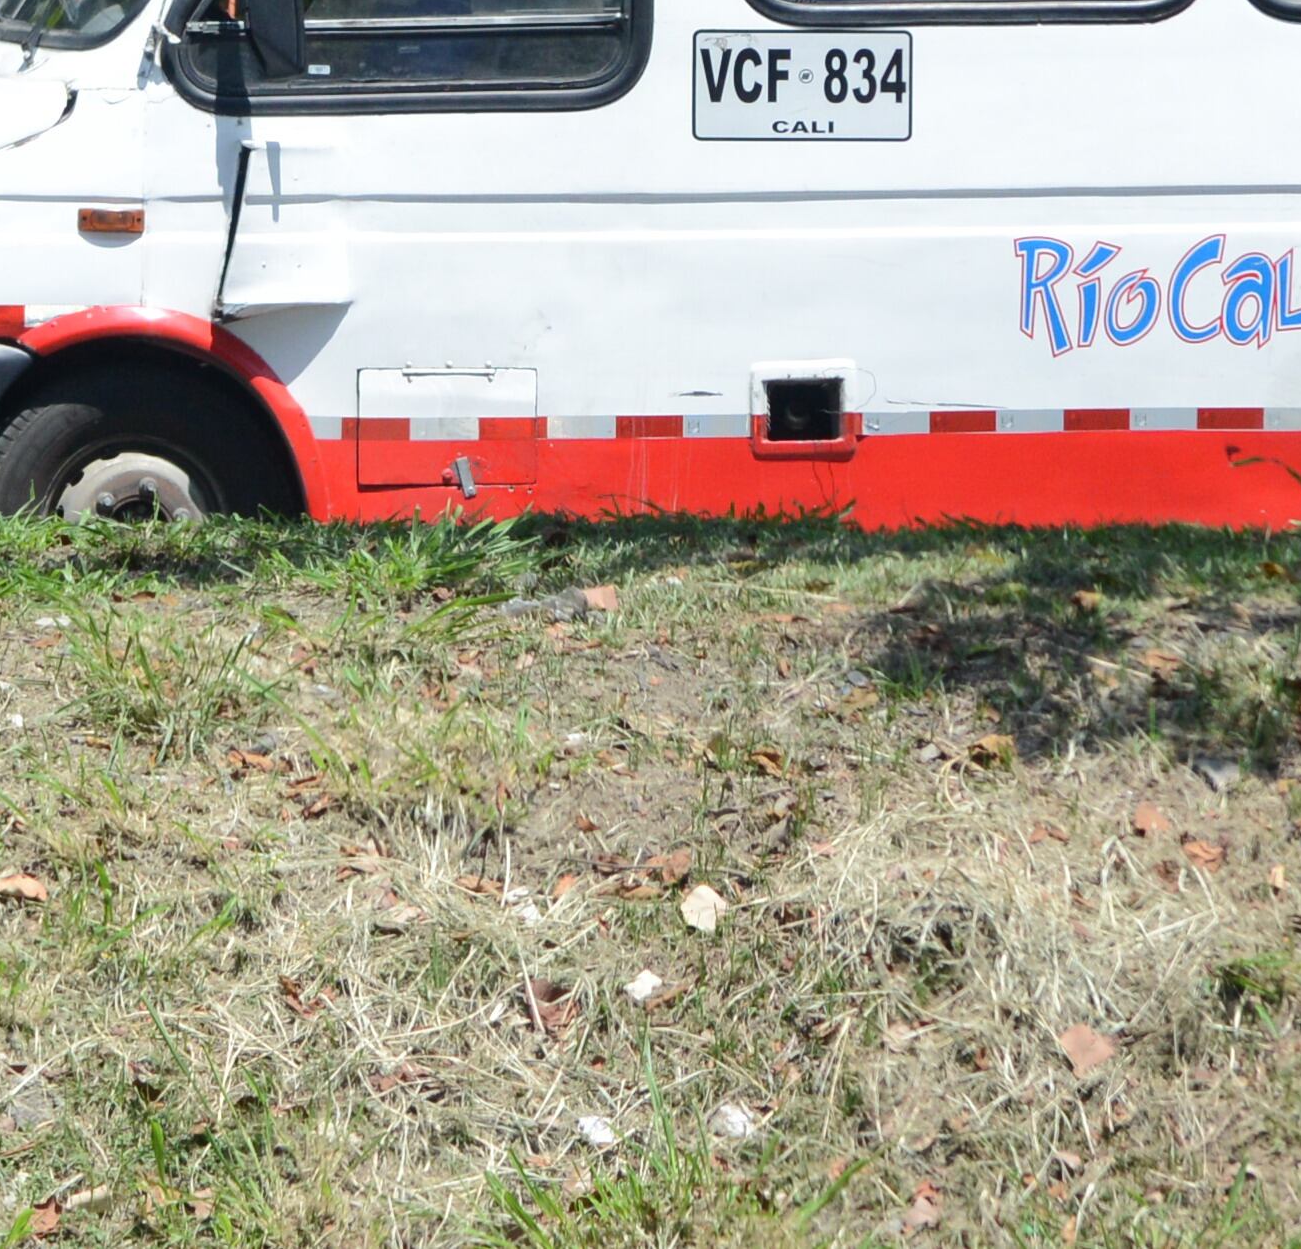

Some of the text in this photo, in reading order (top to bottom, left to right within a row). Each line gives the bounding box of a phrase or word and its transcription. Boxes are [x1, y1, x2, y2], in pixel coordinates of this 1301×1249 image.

[700, 47, 907, 103] VCF 834
[771, 120, 835, 134] CALI
